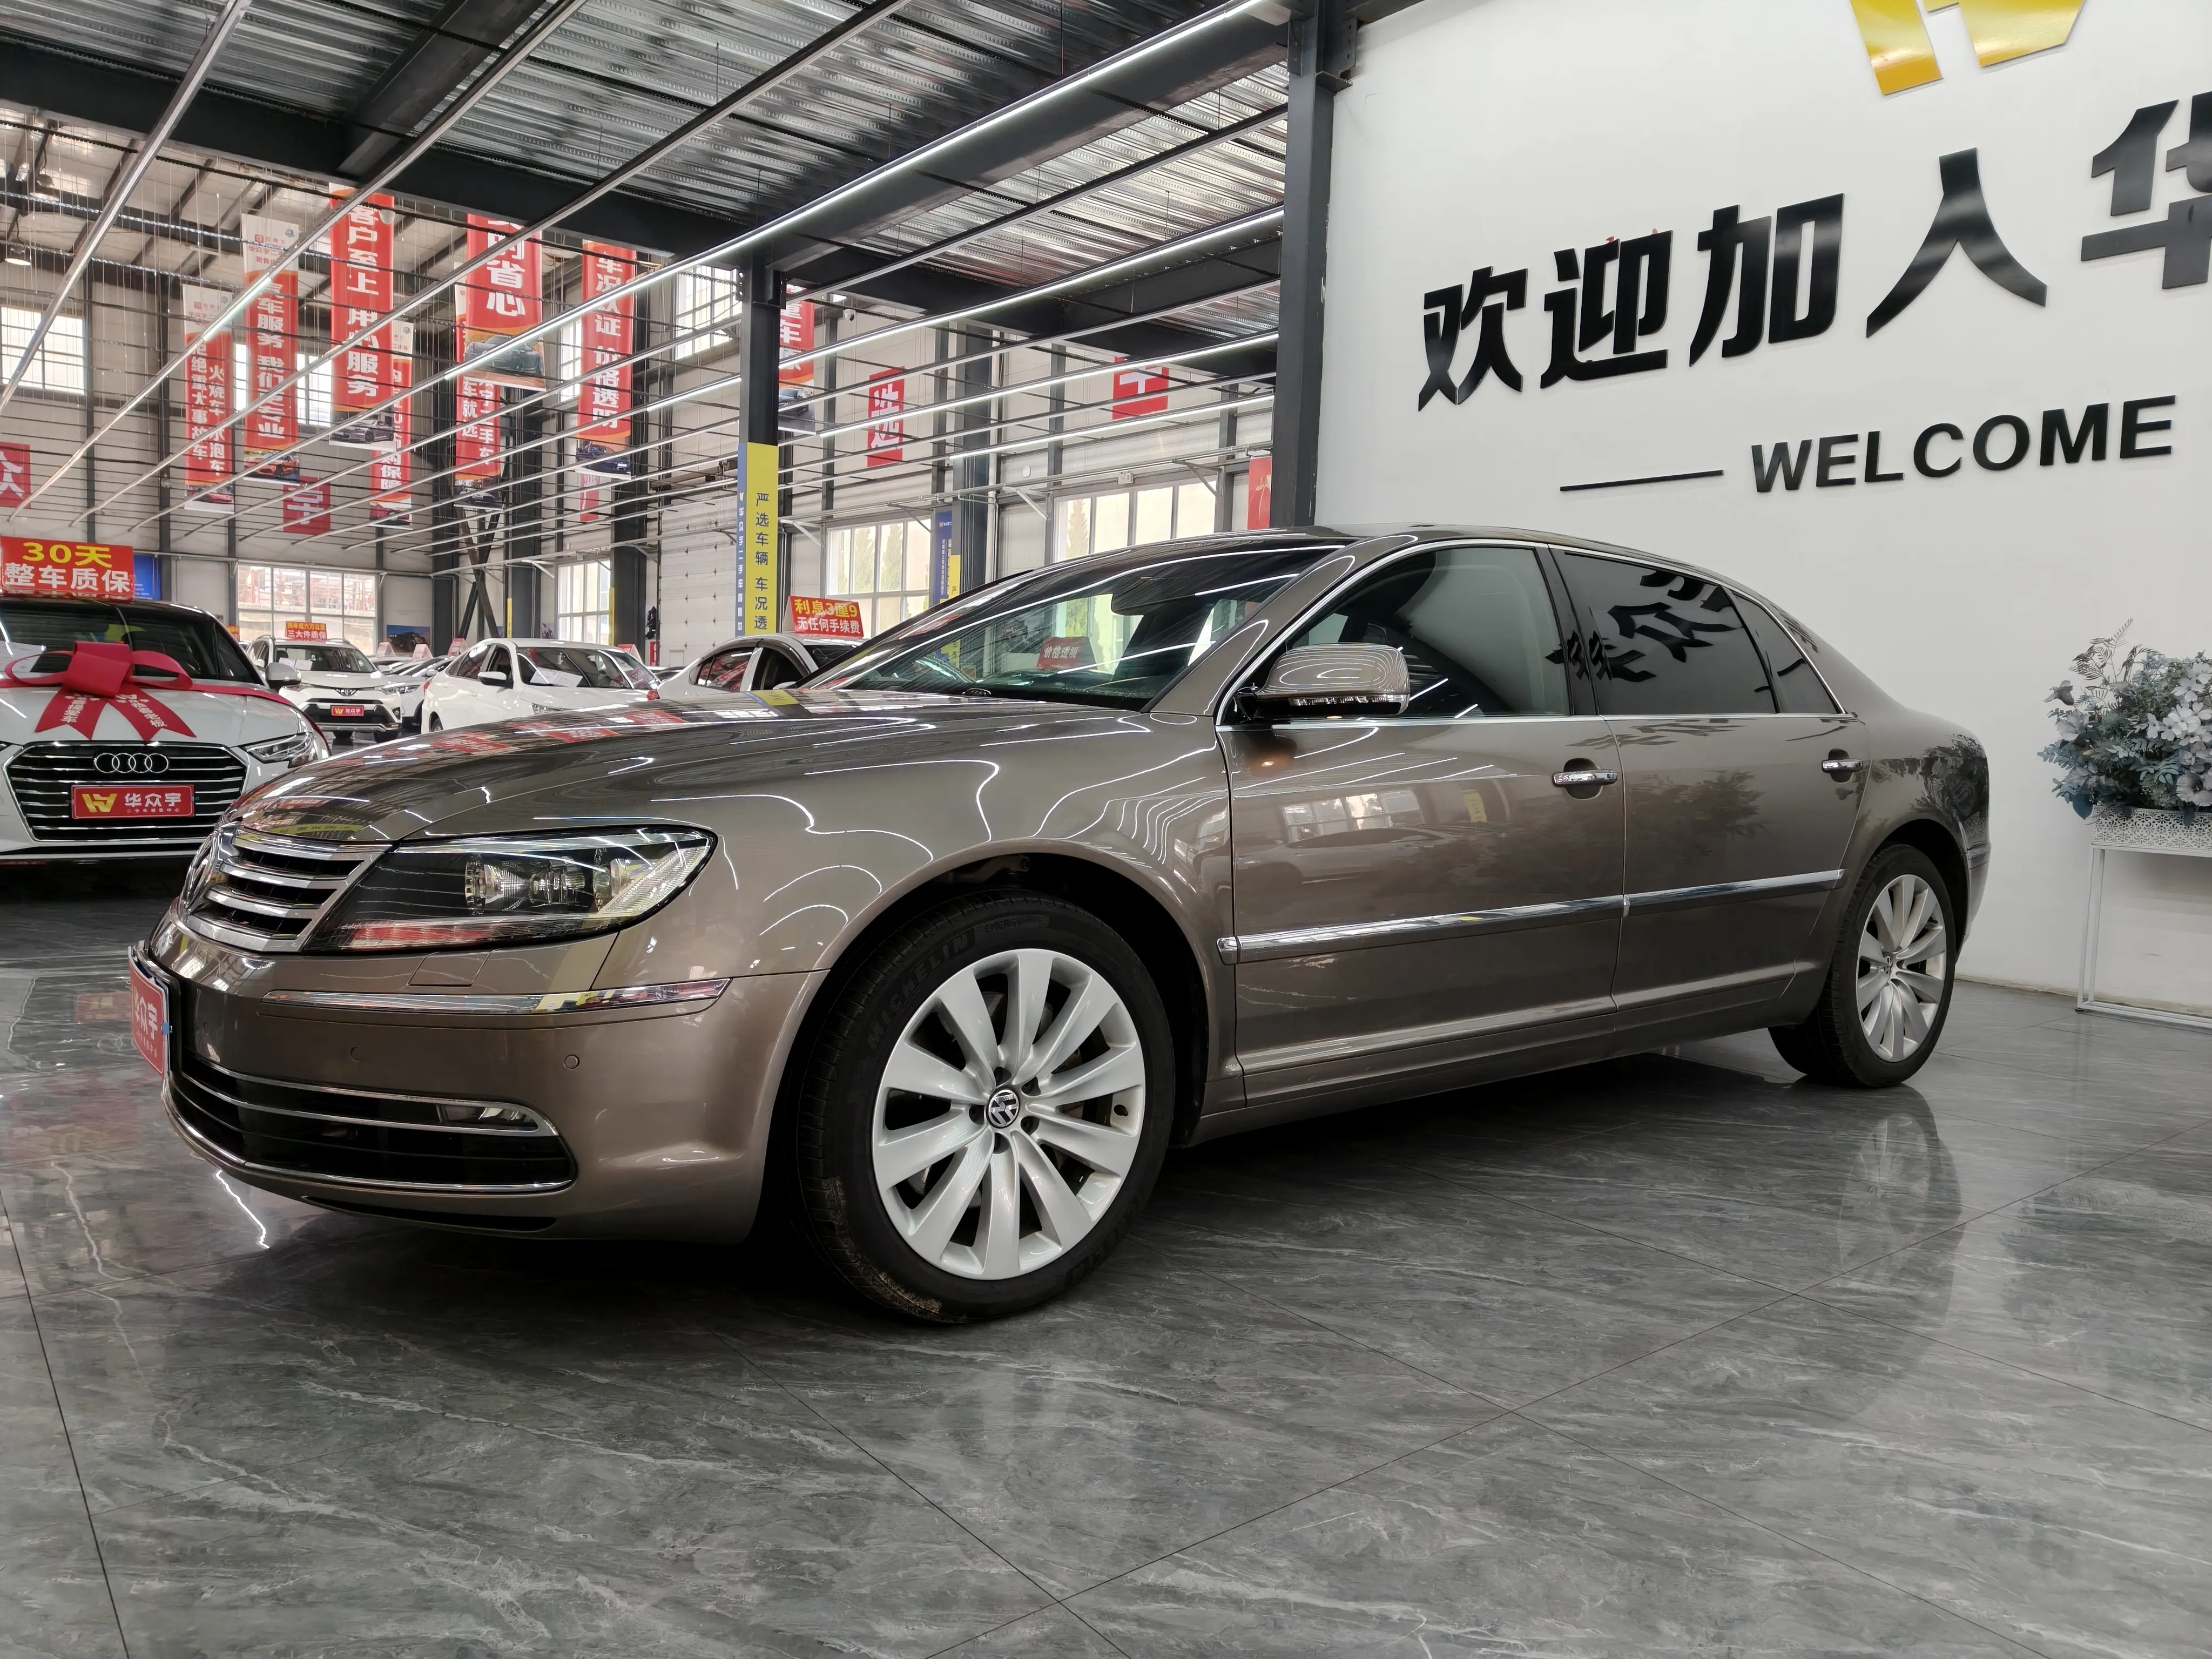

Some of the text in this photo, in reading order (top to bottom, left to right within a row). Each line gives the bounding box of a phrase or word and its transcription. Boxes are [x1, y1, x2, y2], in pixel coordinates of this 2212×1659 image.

[347, 204, 380, 295] 客户至上
[479, 380, 495, 465] 宇二手车
[1751, 395, 2176, 493] WELCOME
[5, 562, 130, 593] 整车质保
[22, 542, 112, 568] 30天
[754, 493, 769, 630] 严选车辆 车况透
[794, 599, 858, 618] 利息3厘9
[797, 616, 860, 634] 无任何手续费
[124, 792, 181, 807] 华众宇
[867, 932, 969, 1051] MICHELIN
